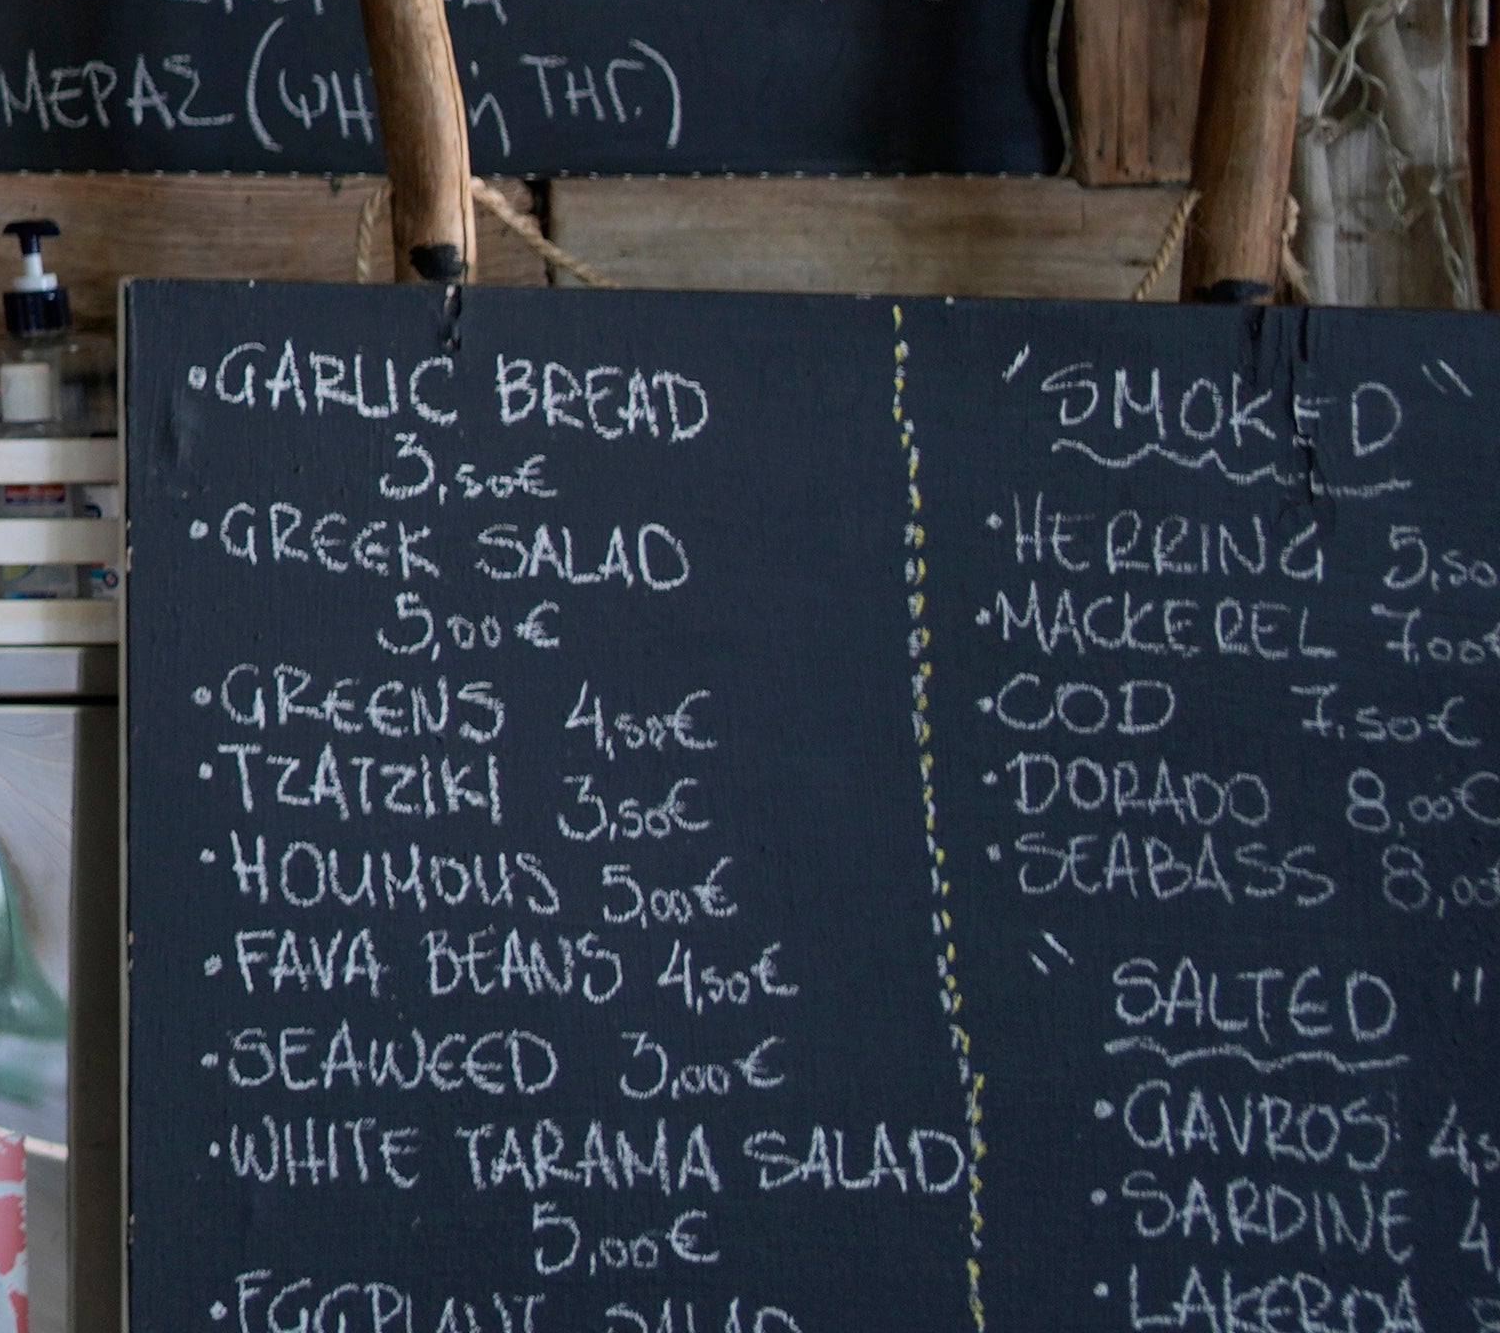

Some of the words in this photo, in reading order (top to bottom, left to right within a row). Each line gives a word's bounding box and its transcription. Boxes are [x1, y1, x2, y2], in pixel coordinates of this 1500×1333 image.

[215, 339, 458, 427] GARLIC
[495, 353, 709, 443] BREAD
[219, 502, 441, 582] GREEK
[475, 523, 691, 592] SALAD
[219, 664, 505, 747] GREENS
[997, 672, 1176, 736] COD
[218, 743, 501, 827] TZATZIKI
[1006, 751, 1271, 826] DORADO
[231, 831, 561, 917] HOUMOUS
[1014, 832, 1335, 909] SEABASS
[234, 929, 390, 997] FAVA
[421, 931, 626, 1005] BEANS
[227, 1019, 560, 1095] SEAWEED
[227, 1115, 421, 1189] WHITE
[456, 1118, 724, 1196] TARAMA
[741, 1122, 966, 1196] SALAD
[1121, 1169, 1414, 1264] SARDINE
